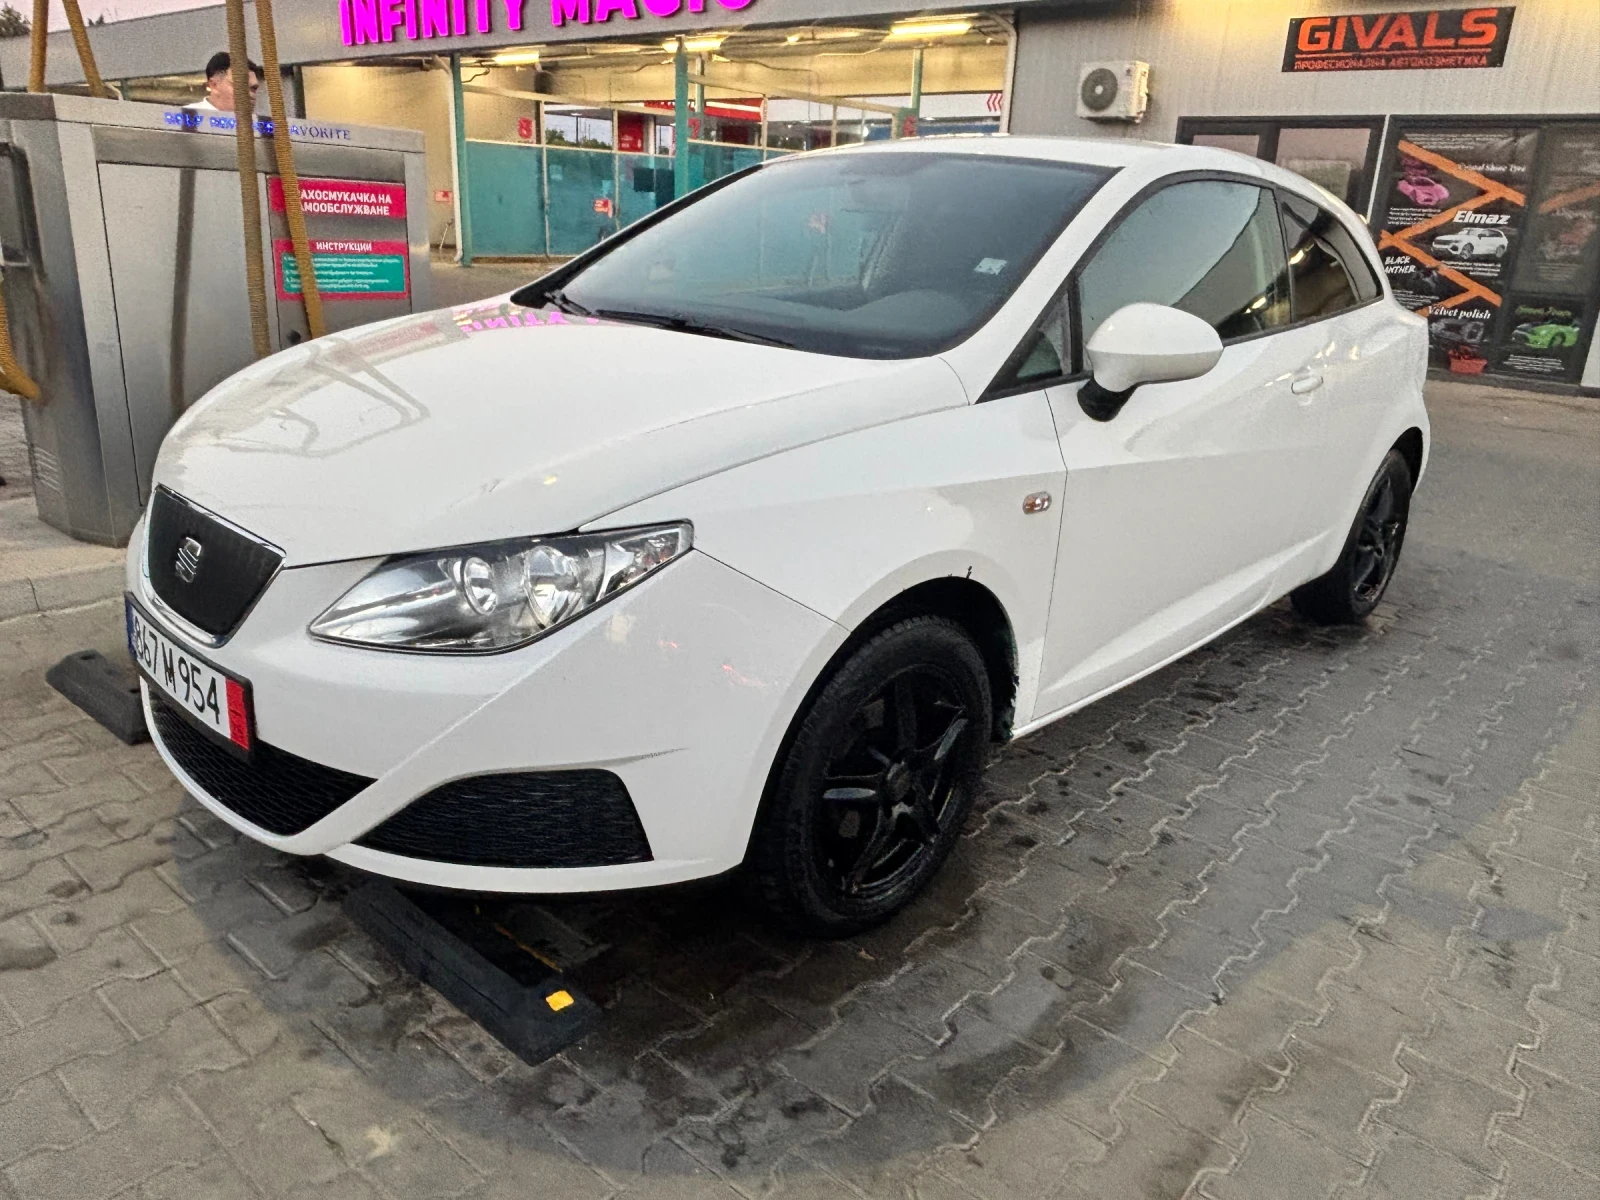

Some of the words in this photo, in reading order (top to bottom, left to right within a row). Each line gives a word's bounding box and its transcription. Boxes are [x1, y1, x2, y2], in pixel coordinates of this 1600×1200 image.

[1297, 8, 1498, 51] GIVALS
[300, 189, 376, 204] АХОСМУКАЧКА
[378, 193, 392, 204] НА
[301, 201, 390, 216] МООБСЛУЖВАНЕ
[1453, 210, 1511, 225] Elmaz
[316, 241, 372, 253] ИНСТРУКЦИИ
[1385, 255, 1411, 265] BLACK
[1384, 264, 1416, 274] ANTHER
[1428, 305, 1458, 319] Velvet
[1458, 309, 1492, 320] polish
[178, 656, 220, 725] 954
